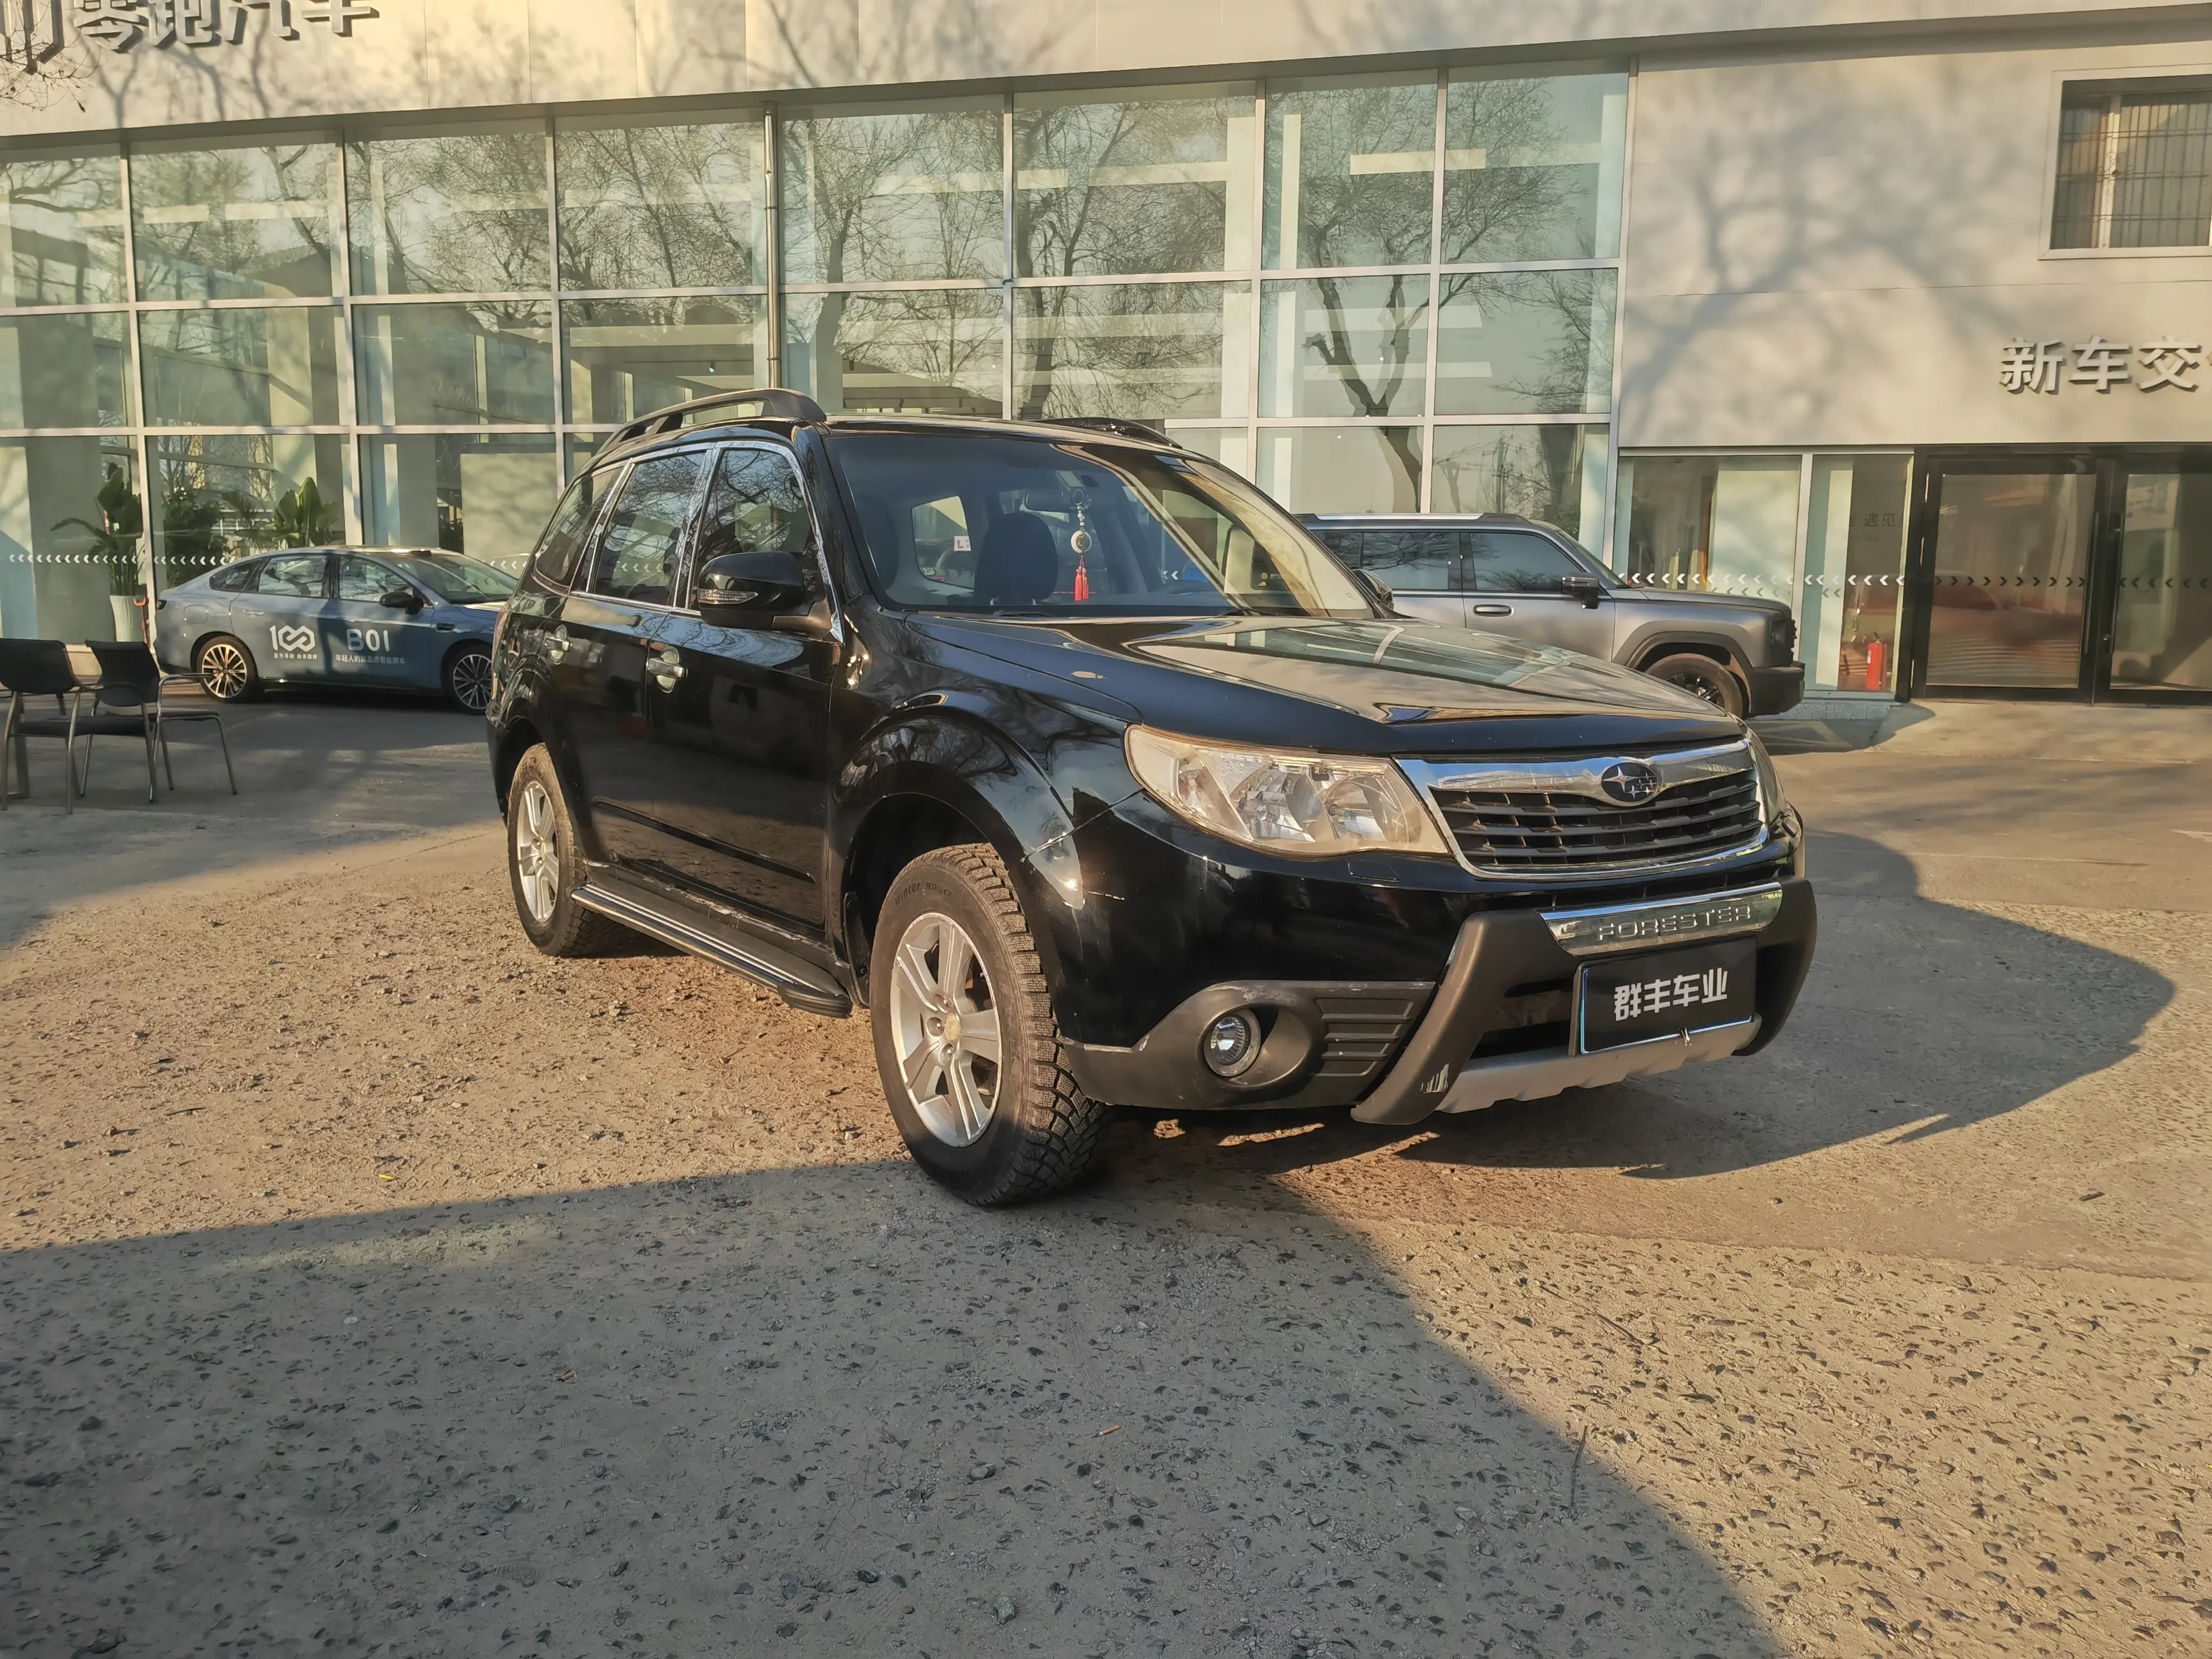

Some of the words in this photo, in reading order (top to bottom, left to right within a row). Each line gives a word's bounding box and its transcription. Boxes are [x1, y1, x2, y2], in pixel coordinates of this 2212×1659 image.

[1999, 335, 2212, 394] 新车交
[1863, 513, 1902, 527] 遇见
[1598, 905, 1752, 941] FORESTER
[1614, 967, 1728, 1021] 群丰车业
